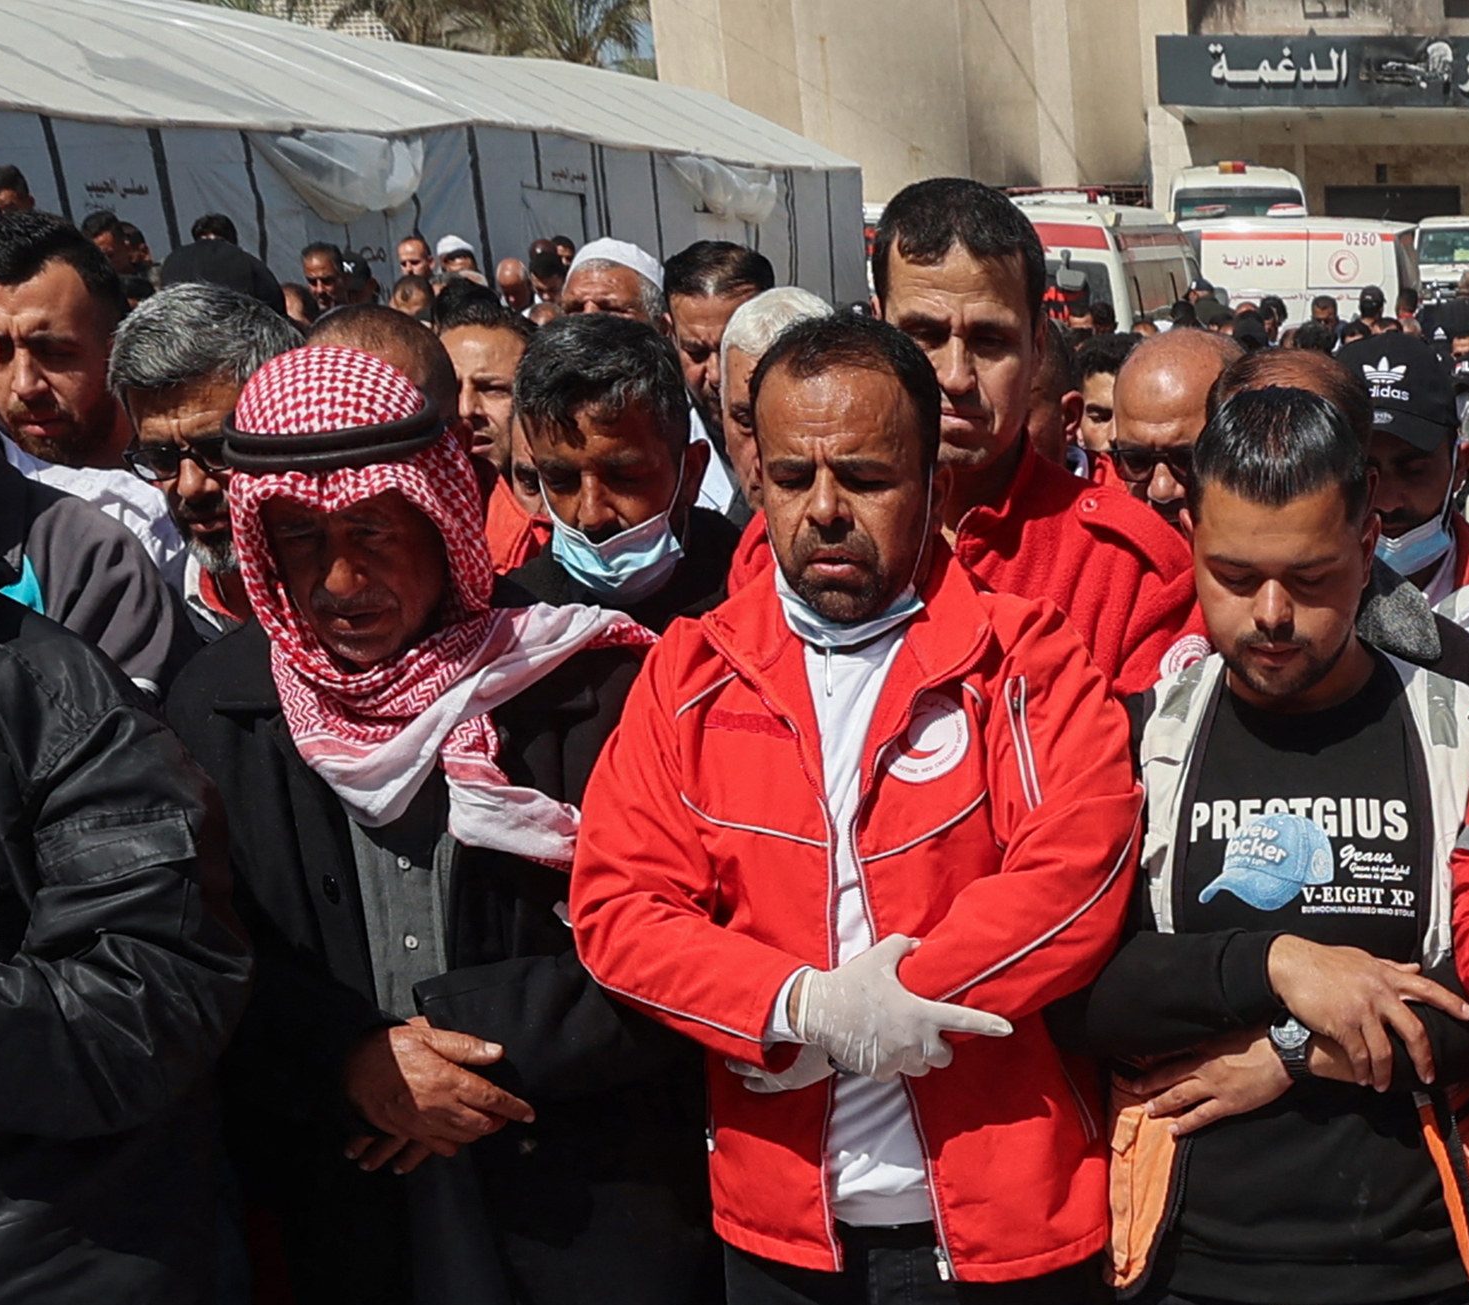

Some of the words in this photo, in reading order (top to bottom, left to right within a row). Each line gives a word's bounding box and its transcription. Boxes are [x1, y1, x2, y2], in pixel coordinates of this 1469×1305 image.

[1207, 43, 1348, 88] الدغمة
[1345, 233, 1377, 247] 0250
[1256, 253, 1287, 268] خدمات
[1301, 886, 1385, 904] V-EIGHT
[1390, 889, 1415, 907] XP
